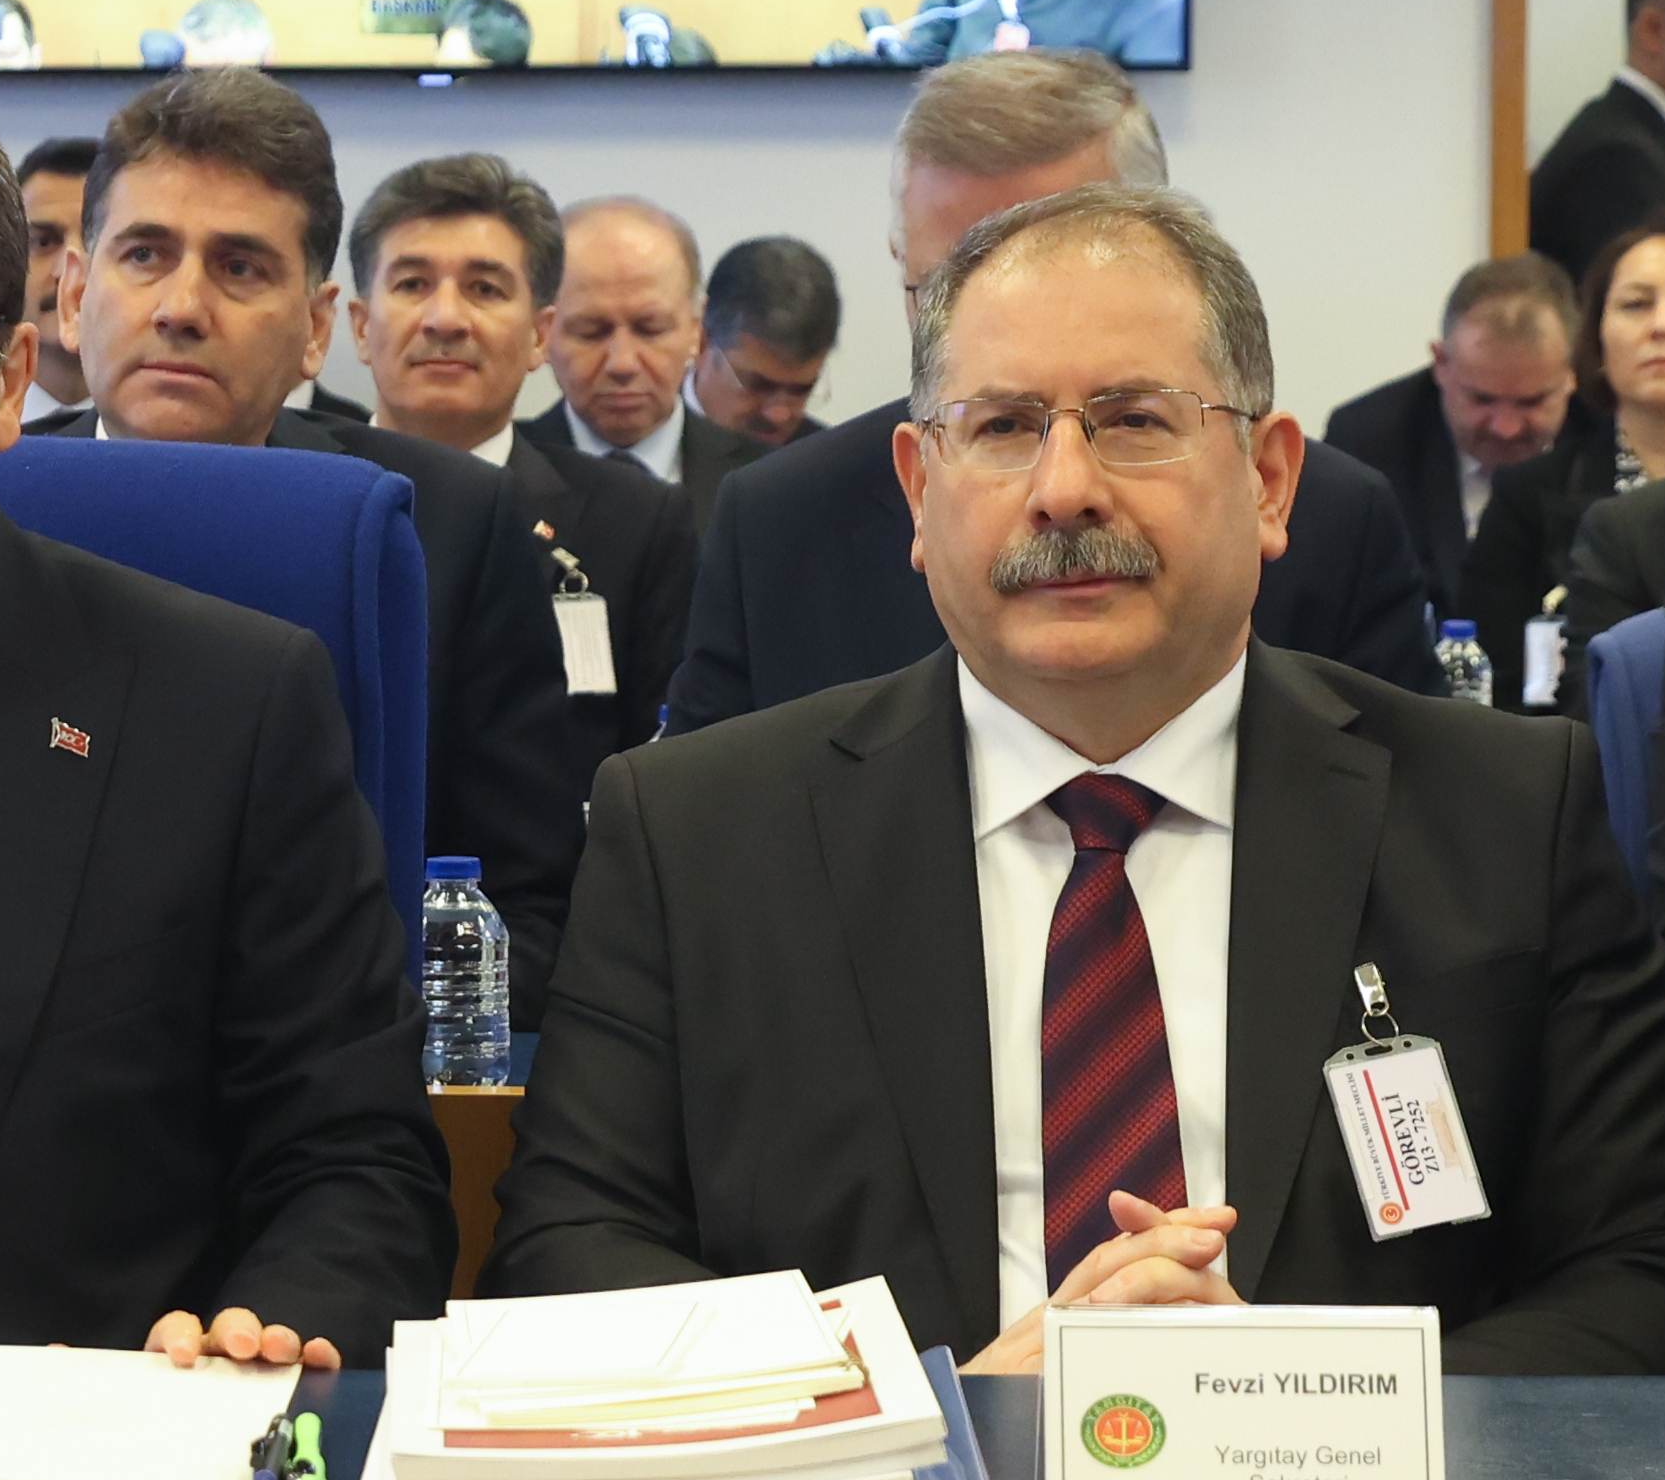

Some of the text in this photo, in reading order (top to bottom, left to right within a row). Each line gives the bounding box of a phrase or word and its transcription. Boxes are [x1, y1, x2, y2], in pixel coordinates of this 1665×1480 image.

[1406, 1100, 1425, 1133] 7252
[1381, 1092, 1425, 1186] GÖREVLİ
[1421, 1146, 1440, 1174] Z13
[1194, 1373, 1398, 1396] Fevzi YILDIRIM
[1214, 1445, 1381, 1470] Yargıtay Genel
